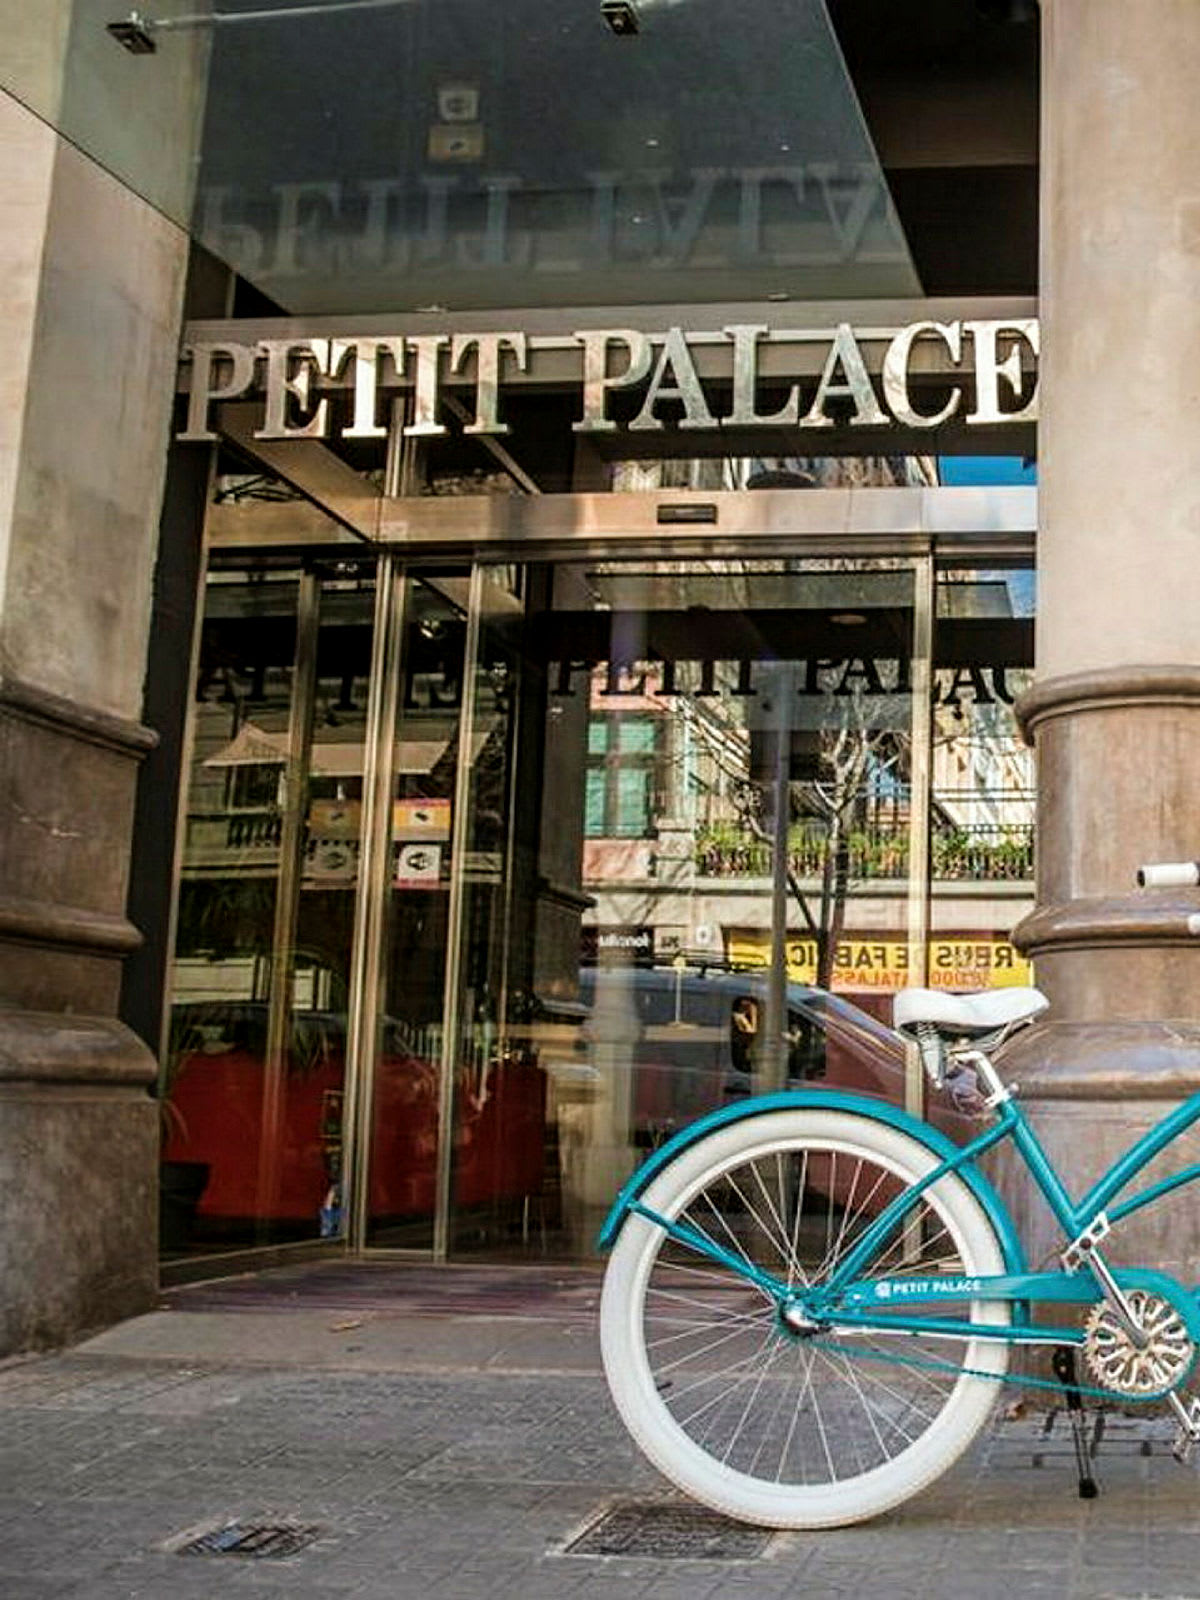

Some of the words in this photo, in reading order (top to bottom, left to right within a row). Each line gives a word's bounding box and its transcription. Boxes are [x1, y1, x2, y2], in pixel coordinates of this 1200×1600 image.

[176, 331, 527, 441] PETIT
[572, 318, 1040, 432] PALACE
[893, 1281, 929, 1294] PETIT
[933, 1279, 981, 1293] PALACE
